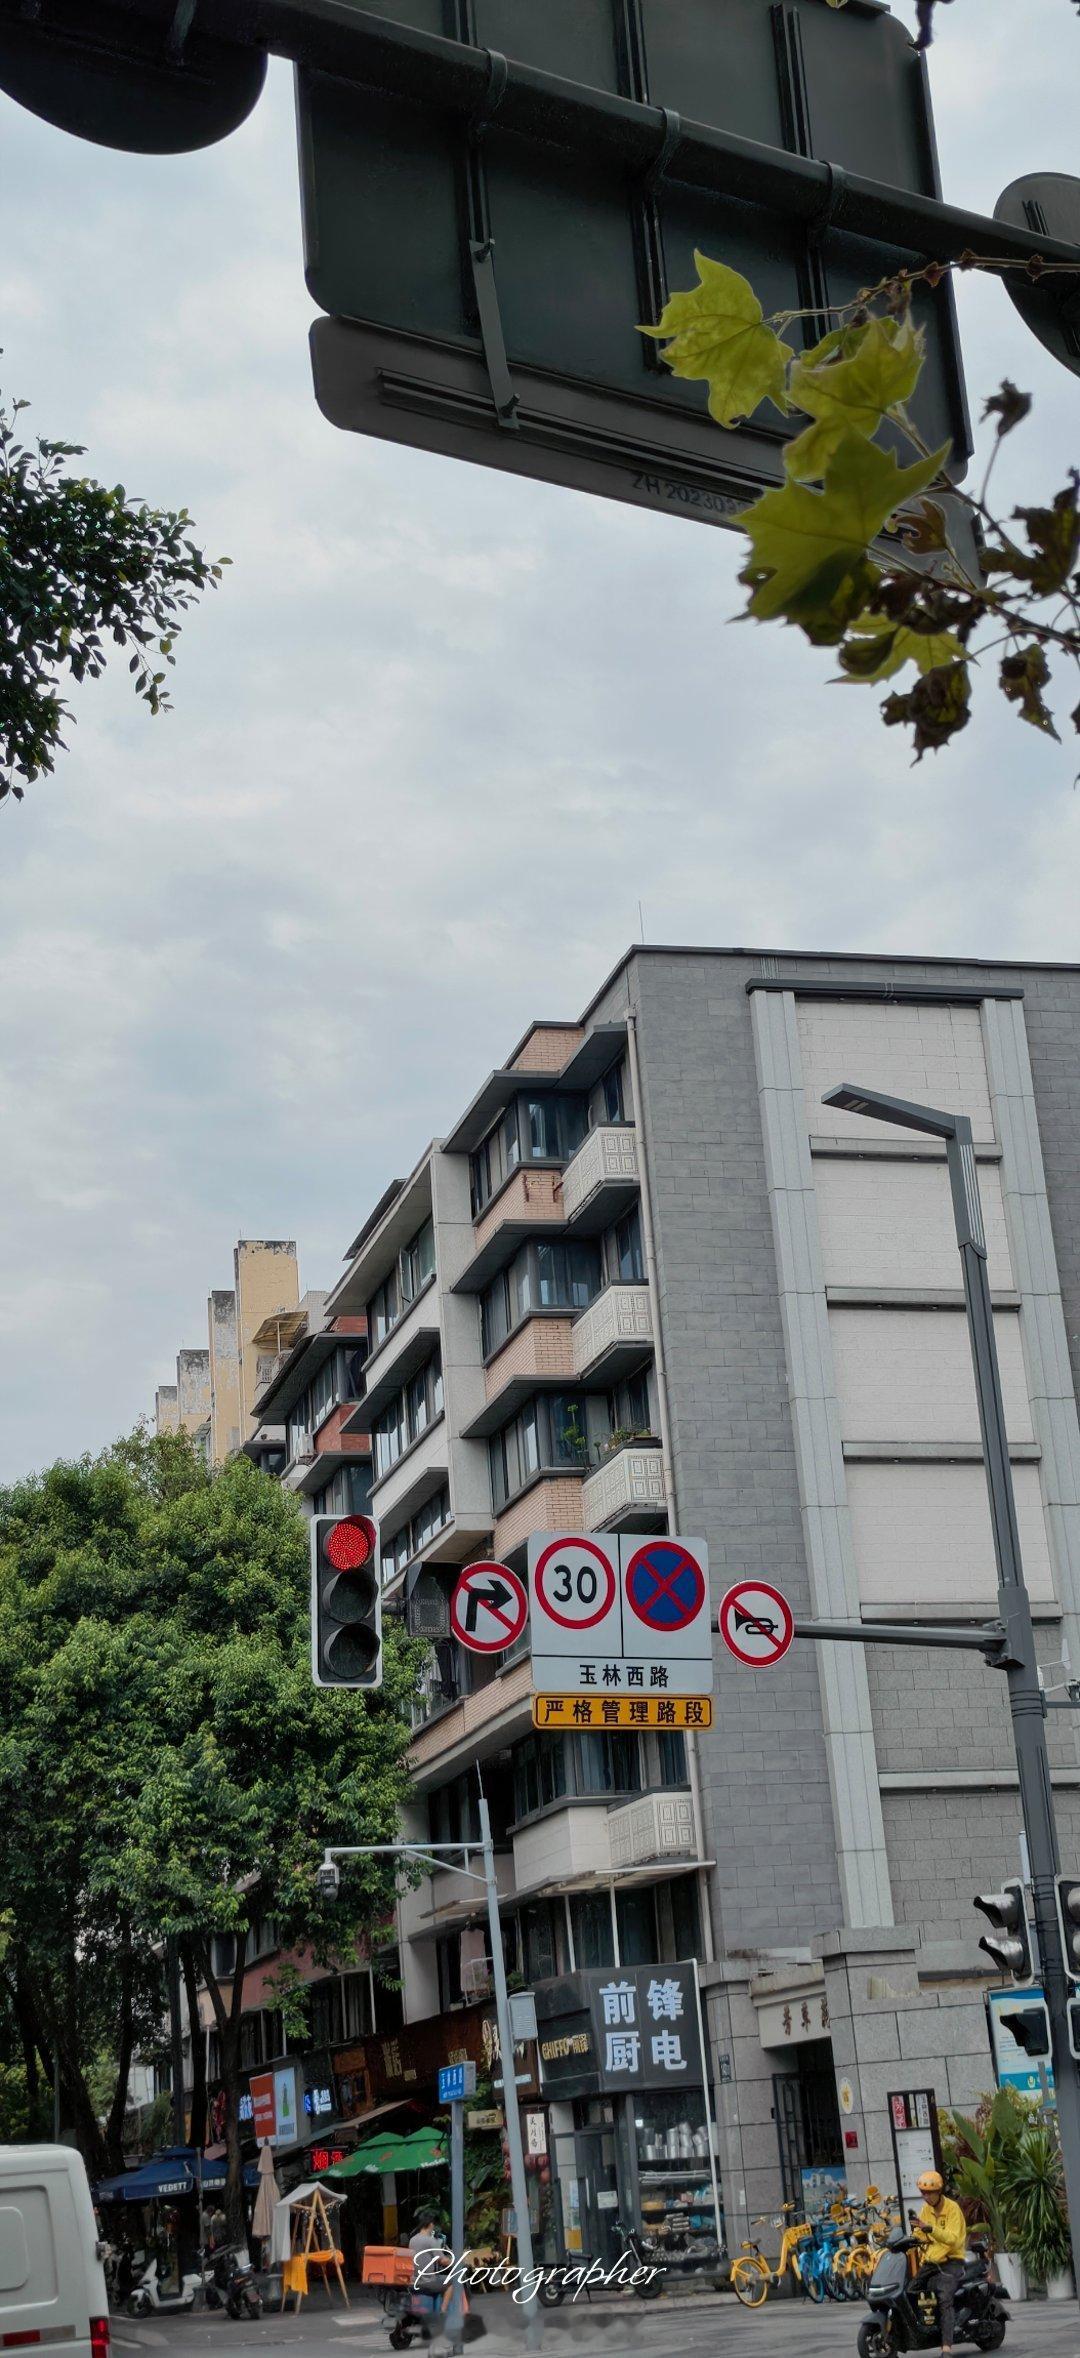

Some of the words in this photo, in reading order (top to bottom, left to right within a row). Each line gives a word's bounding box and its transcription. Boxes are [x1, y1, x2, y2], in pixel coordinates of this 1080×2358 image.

[552, 1564, 597, 1604] 30
[579, 1664, 669, 1689] 玉林西路
[545, 1700, 704, 1724] 严格管理路段
[599, 1978, 684, 2025] 前锋
[605, 2029, 687, 2073] 厨电
